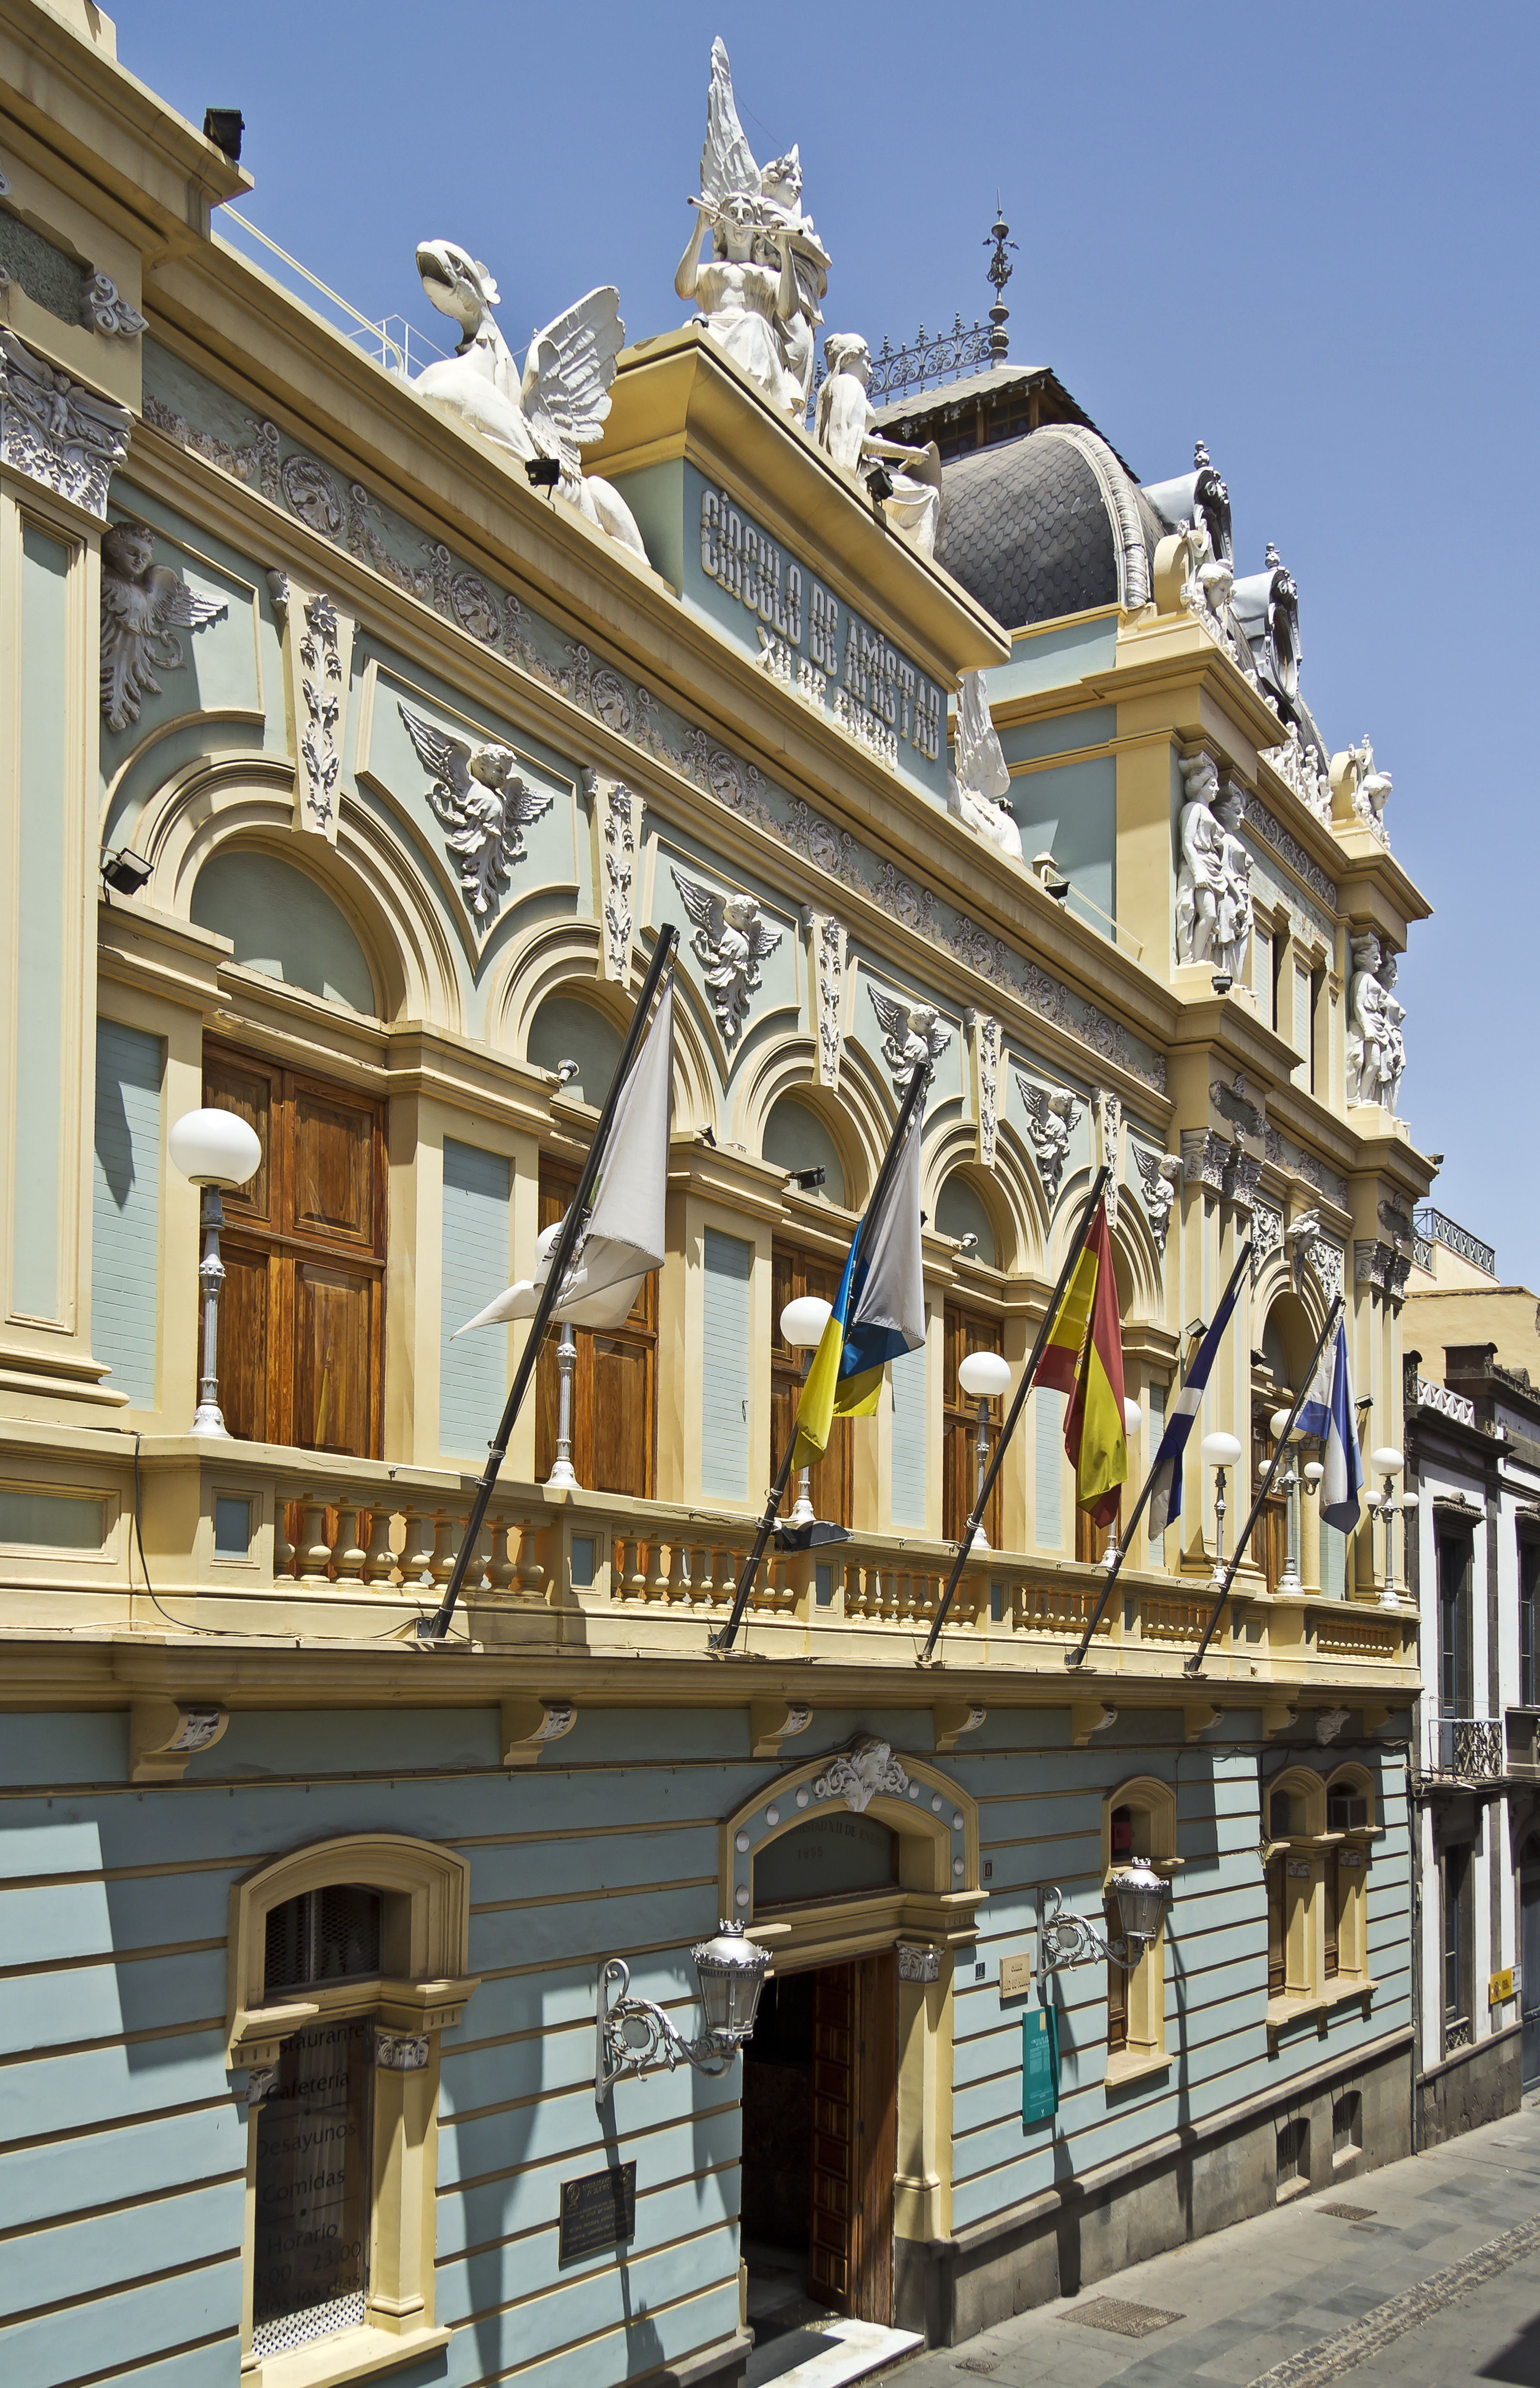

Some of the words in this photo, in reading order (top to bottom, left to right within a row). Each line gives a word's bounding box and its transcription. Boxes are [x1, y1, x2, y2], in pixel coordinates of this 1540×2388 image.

[809, 582, 838, 676] DE
[842, 616, 940, 760] AMISTAD
[755, 626, 792, 688] XII
[796, 657, 826, 715] DE
[833, 686, 898, 770] ENERO
[828, 1821, 842, 1835] XII
[845, 1824, 856, 1837] DE
[977, 1964, 983, 1976] 12
[266, 2068, 349, 2100] Cafetería
[256, 2122, 356, 2160] Desayunos
[263, 2169, 346, 2203] Comidas
[267, 2222, 337, 2257] Horario
[254, 2296, 289, 2318] dos
[297, 2286, 321, 2305] los
